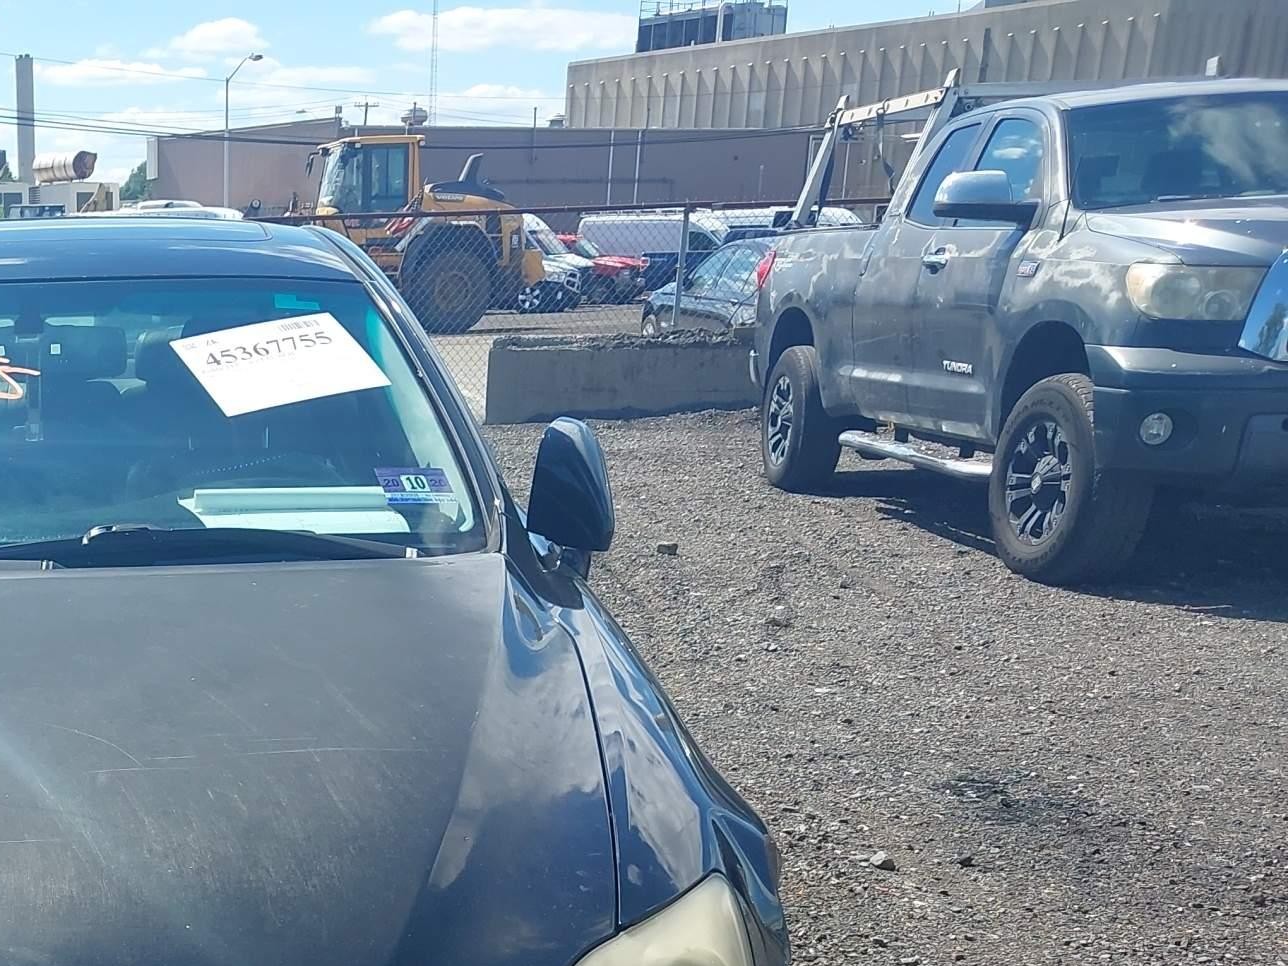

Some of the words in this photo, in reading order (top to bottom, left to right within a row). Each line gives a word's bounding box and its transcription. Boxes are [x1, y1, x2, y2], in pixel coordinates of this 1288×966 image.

[206, 331, 333, 367] 45367755
[942, 360, 973, 374] TUNDRA
[383, 478, 400, 488] 20
[405, 476, 426, 490] 10
